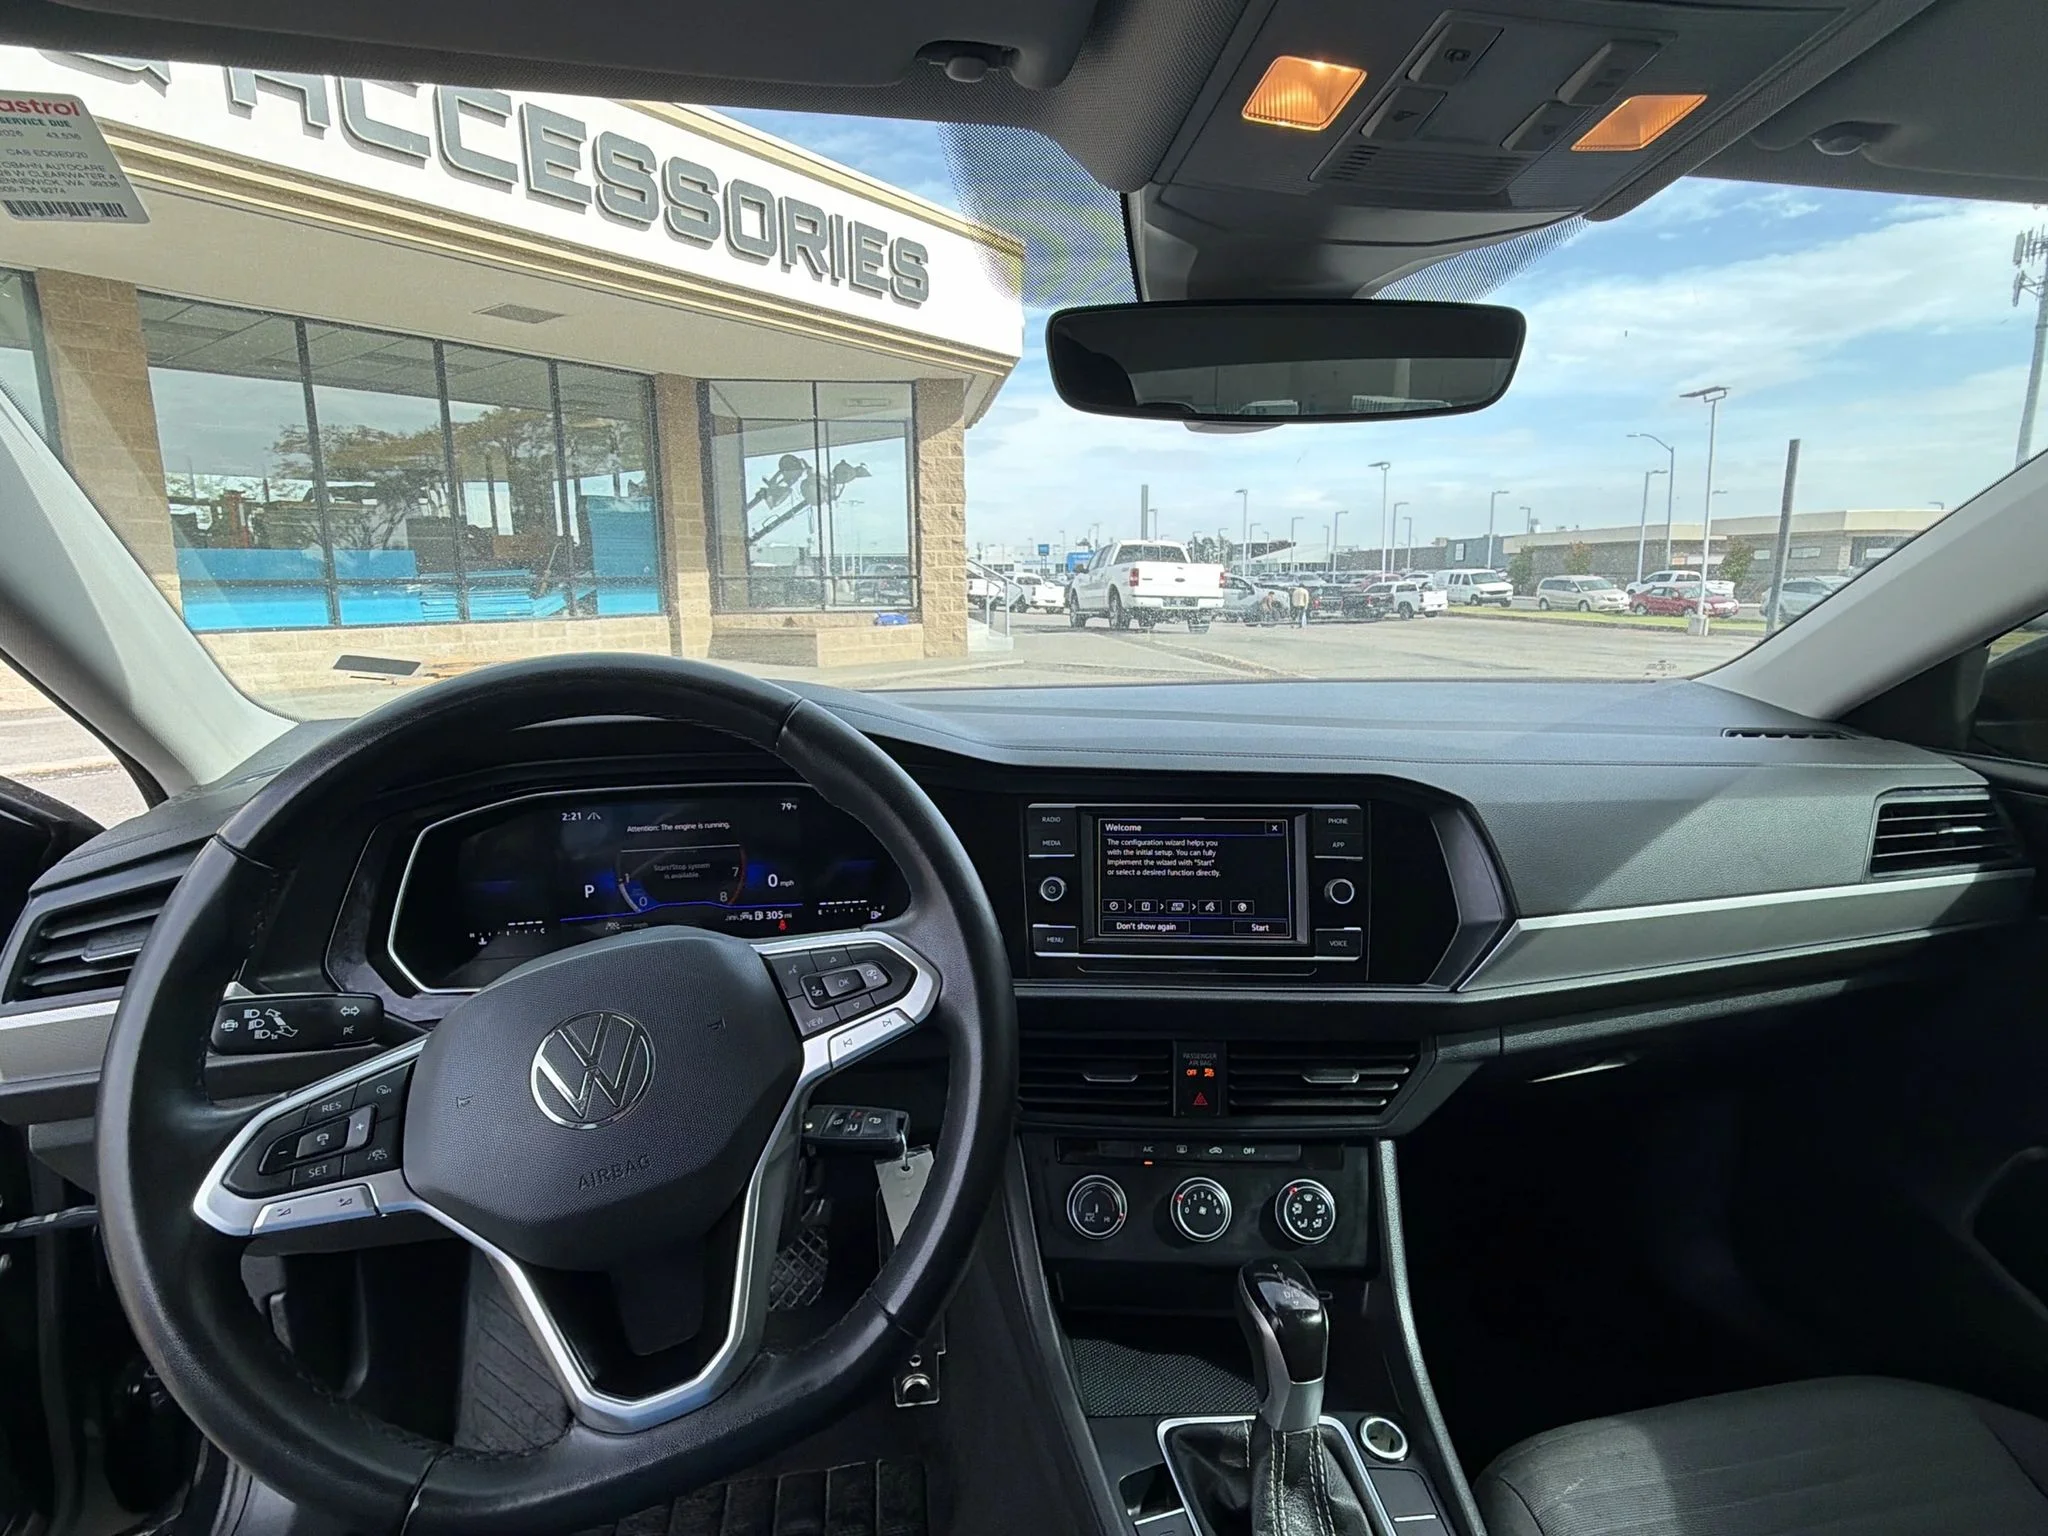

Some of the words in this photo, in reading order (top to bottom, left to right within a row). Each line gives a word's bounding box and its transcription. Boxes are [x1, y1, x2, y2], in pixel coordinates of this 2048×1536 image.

[0, 117, 46, 126] SERVICE
[49, 119, 72, 128] DUE
[0, 161, 42, 169] OBAHN
[46, 163, 105, 172] AUTOCARE
[28, 170, 105, 181] CLEARWATER
[561, 812, 582, 821] 2:21
[626, 825, 659, 833] Attention:
[661, 823, 673, 831] The
[674, 823, 697, 832] engine
[704, 822, 730, 830] running.
[1105, 823, 1142, 832] Welcome
[1107, 838, 1119, 846] The
[1121, 839, 1163, 847] configuration
[1187, 840, 1204, 848] helps
[1107, 848, 1121, 856] with
[1155, 850, 1174, 858] setup.
[1203, 849, 1216, 858] fully
[1107, 859, 1142, 867] implement
[732, 867, 739, 877] 7
[1116, 868, 1135, 876] select
[1196, 869, 1221, 878] directly.
[767, 873, 778, 887] 0
[584, 885, 595, 898] P
[639, 897, 648, 907] 0
[720, 892, 728, 902] 8
[766, 910, 784, 920] 305
[1157, 923, 1176, 932] again
[838, 979, 850, 987] OK
[806, 1017, 825, 1028] VIEW
[321, 1102, 342, 1113] RES
[308, 1166, 328, 1177] SET
[579, 1154, 651, 1190] AIRBAG
[1184, 1206, 1190, 1214] 0
[1193, 1193, 1198, 1201] 2
[1207, 1193, 1212, 1201] 4
